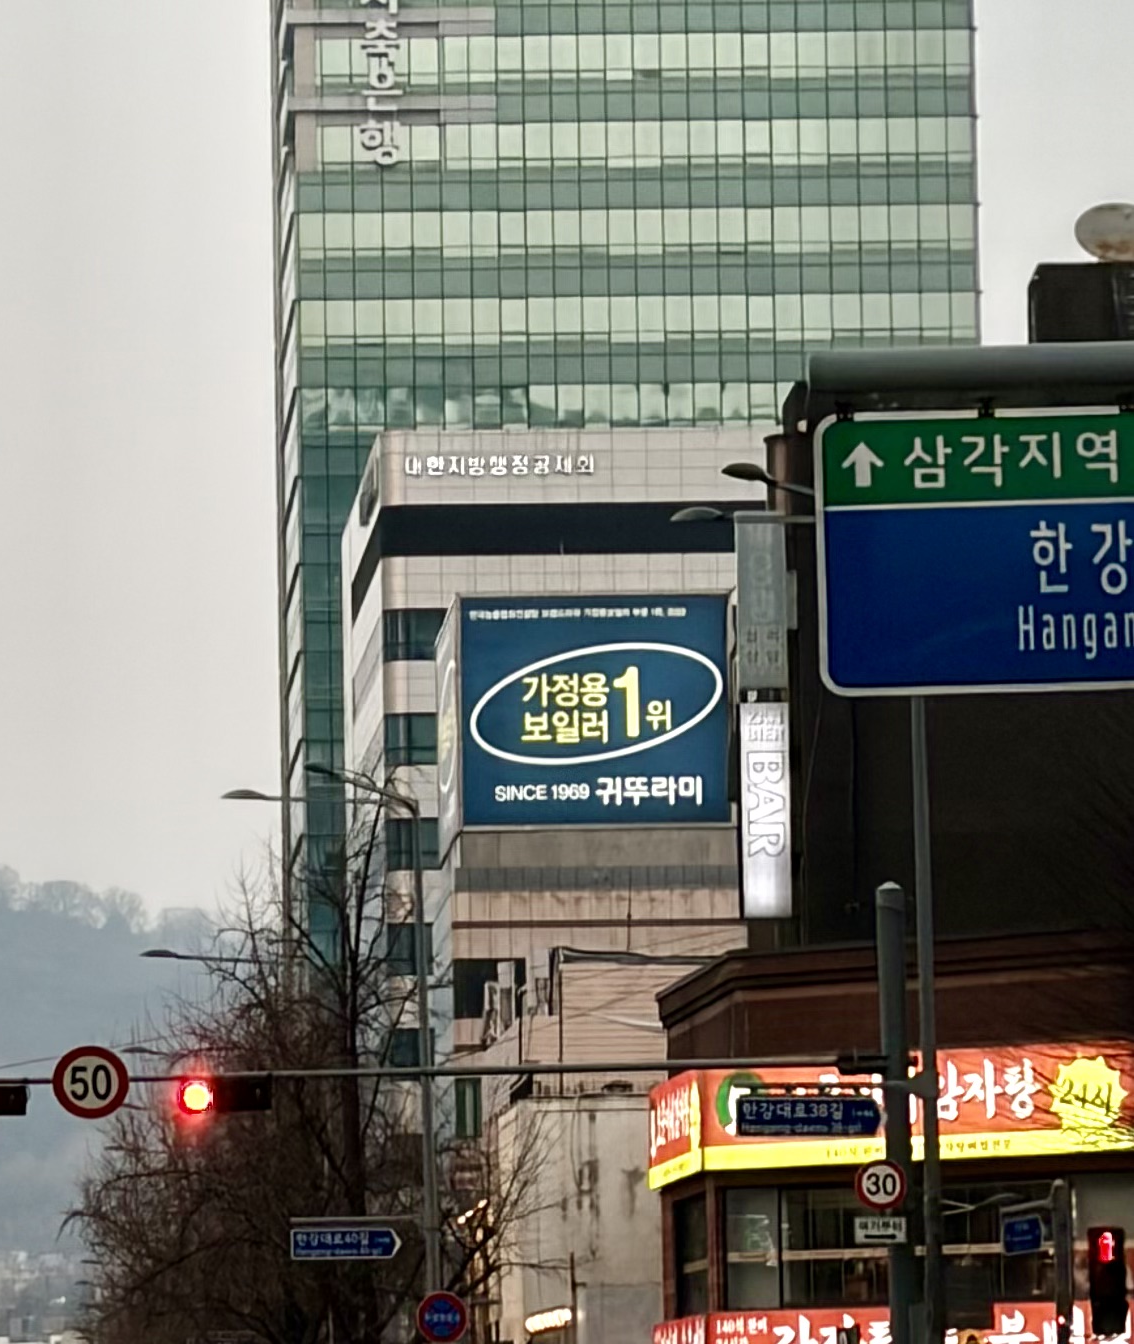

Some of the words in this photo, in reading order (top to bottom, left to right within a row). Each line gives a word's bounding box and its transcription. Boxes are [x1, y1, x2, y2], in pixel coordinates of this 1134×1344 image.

[904, 430, 1118, 488] 삼각지역
[522, 673, 609, 708] 가정용
[521, 709, 609, 744] 보일러
[494, 785, 548, 802] SINCE
[551, 783, 590, 800] 1969
[595, 776, 703, 806] 귀뚜라미
[747, 751, 786, 857] BAR
[70, 1064, 112, 1101] 50
[742, 1101, 844, 1120] 한강대로38길
[867, 1173, 897, 1196] 30
